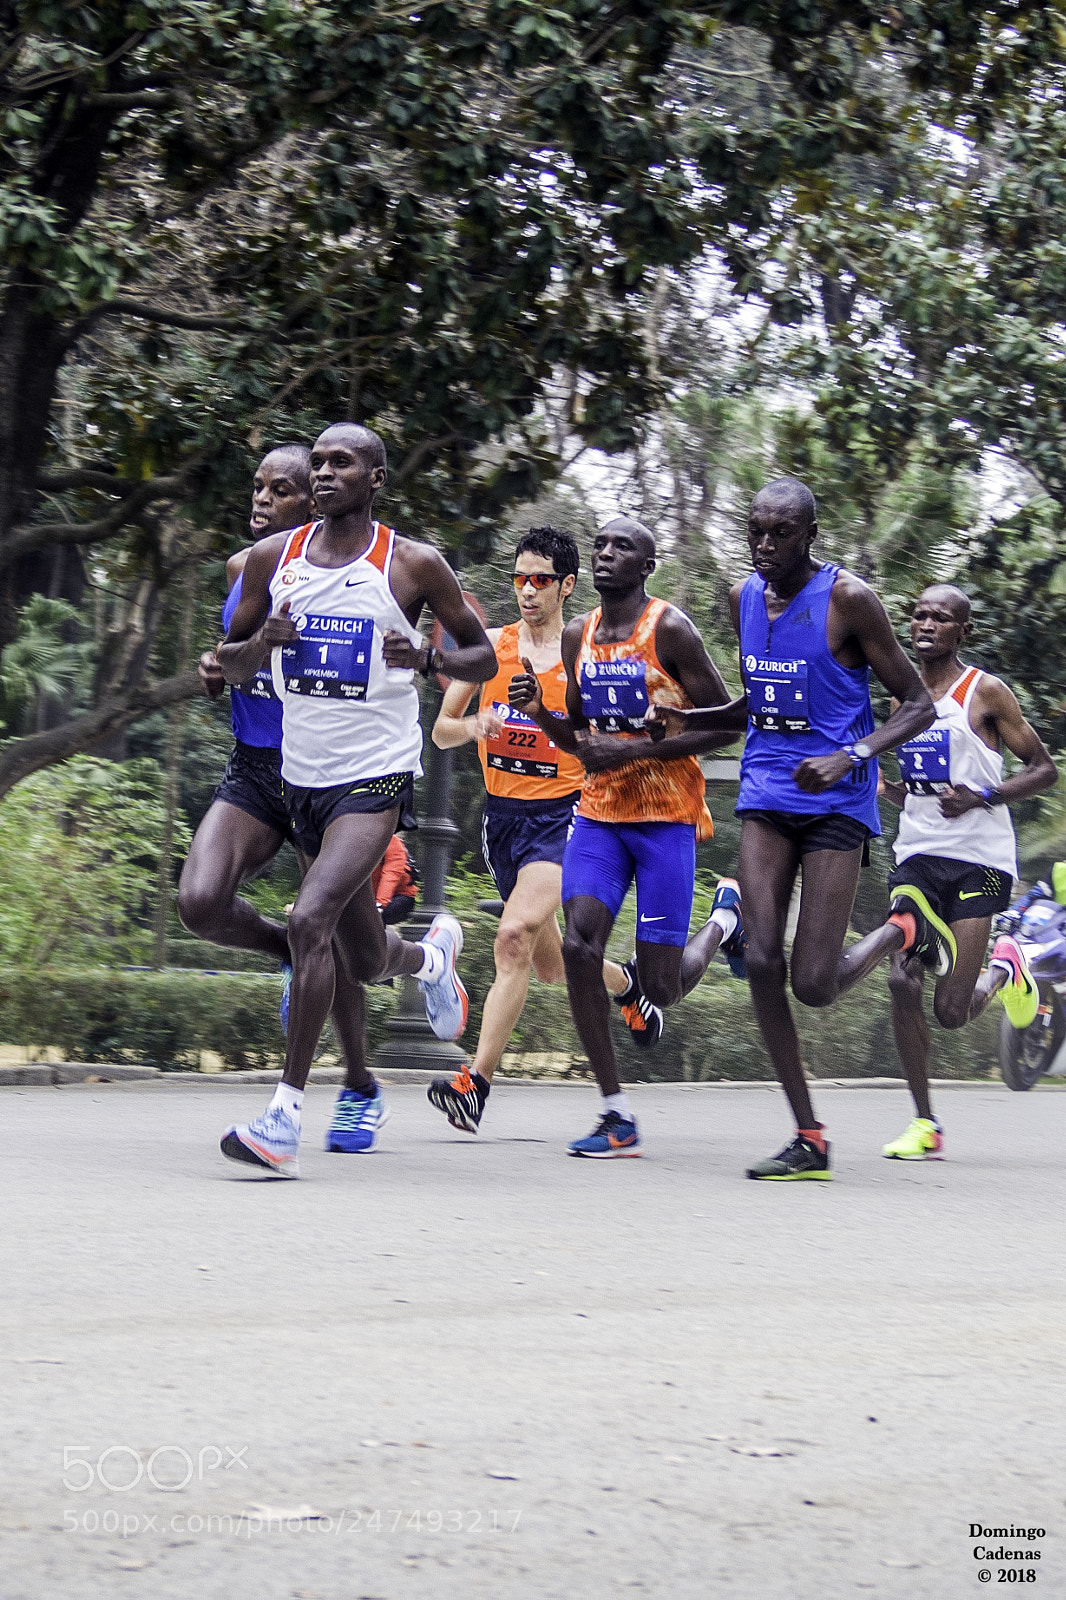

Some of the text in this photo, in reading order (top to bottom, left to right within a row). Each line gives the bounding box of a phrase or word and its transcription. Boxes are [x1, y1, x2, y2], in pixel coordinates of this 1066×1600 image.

[310, 617, 363, 634] ZURICH
[319, 644, 329, 665] 1
[597, 663, 638, 676] ZURICH
[757, 660, 798, 673] ZURICH
[607, 686, 618, 705] 6
[764, 685, 776, 702] 8
[507, 731, 537, 748] 222
[913, 752, 924, 770] 2
